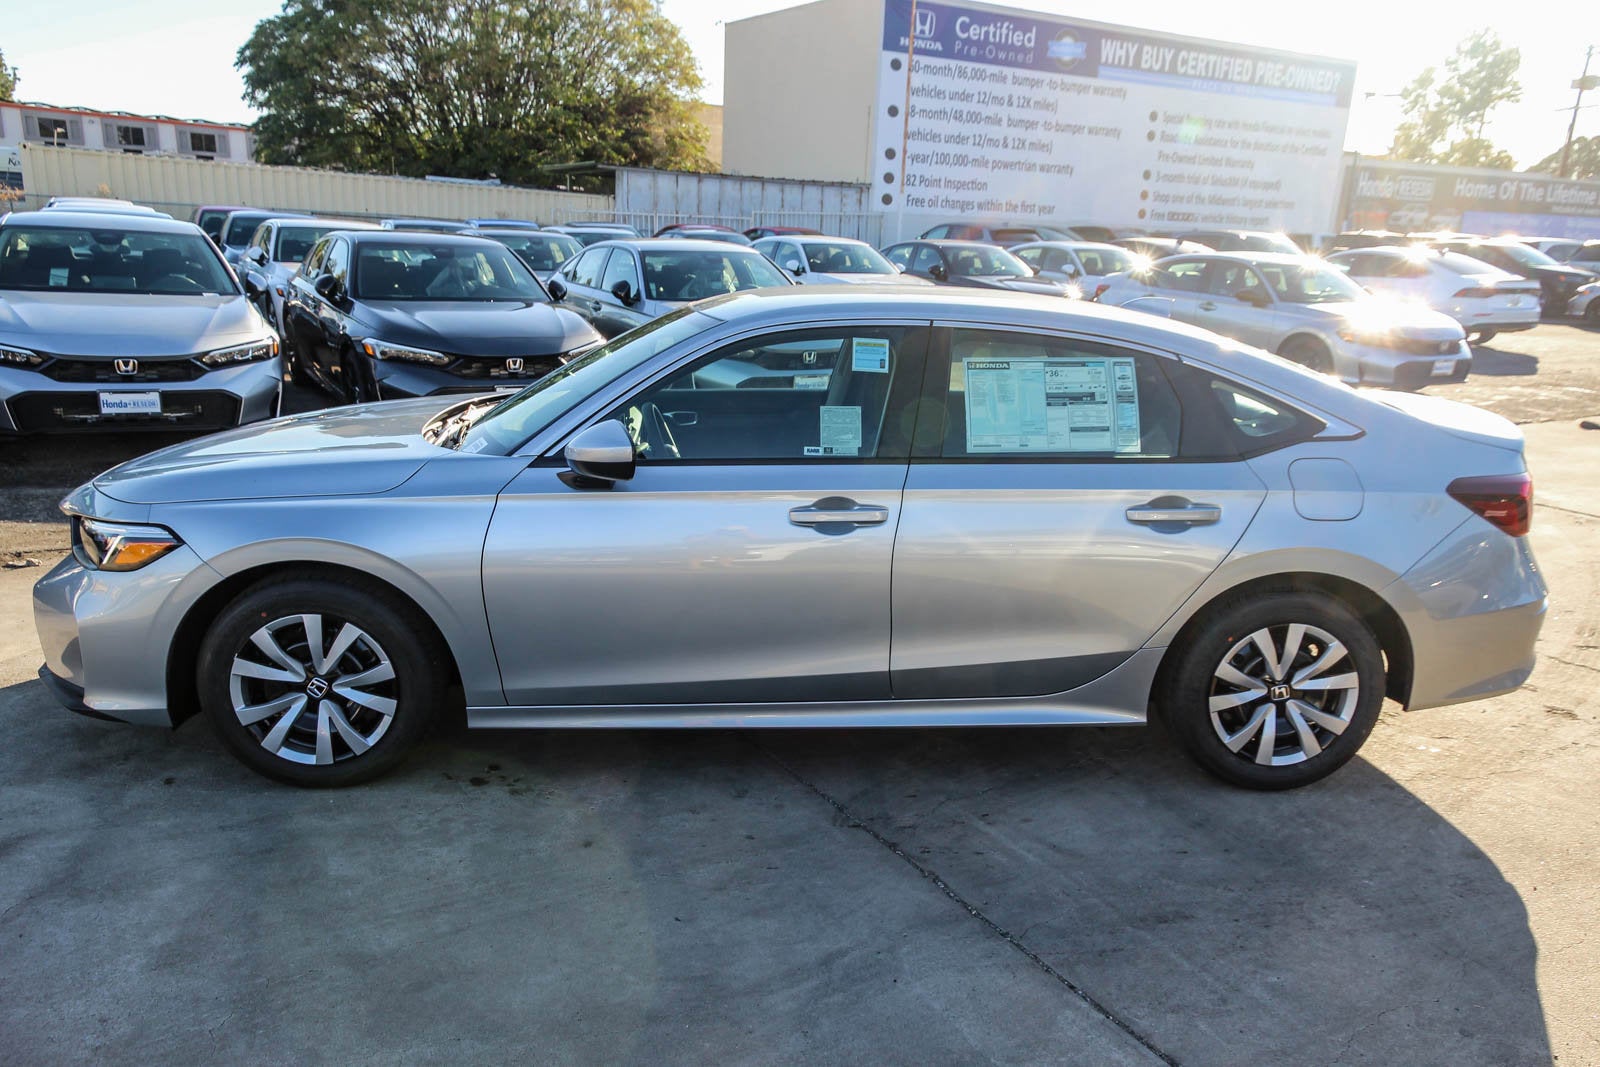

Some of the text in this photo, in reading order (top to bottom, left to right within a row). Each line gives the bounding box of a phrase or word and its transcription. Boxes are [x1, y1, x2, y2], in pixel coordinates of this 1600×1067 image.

[900, 36, 943, 51] HNDA
[955, 16, 1036, 48] Certified
[954, 40, 1034, 64] Pre-Owned
[1100, 39, 1138, 65] WHY
[1141, 46, 1175, 71] BUY
[1177, 51, 1251, 82] CERTIFIED
[1254, 60, 1341, 94] PRE-OWNED?
[911, 60, 1008, 84] 0-month/86,000-mile
[1012, 72, 1044, 90] bumper
[1093, 85, 1127, 101] warranty
[949, 88, 975, 103] under
[977, 90, 1005, 107] 12/mo
[1007, 93, 1013, 107] &
[909, 104, 1003, 127] 8-month/48,000-mile
[1007, 113, 1040, 132] bumper
[1088, 125, 1122, 141] warranty
[944, 132, 970, 148] under
[972, 134, 999, 151] 12/mo
[1002, 135, 1008, 149] &
[907, 149, 990, 170] -year/100,000-mile
[1039, 163, 1074, 178] warranty
[906, 174, 988, 193] 82 Point Inspection
[1454, 178, 1597, 206] Home Of The Lifetime
[906, 194, 1056, 216] Free oil changes within the first year
[102, 399, 129, 409] Honda
